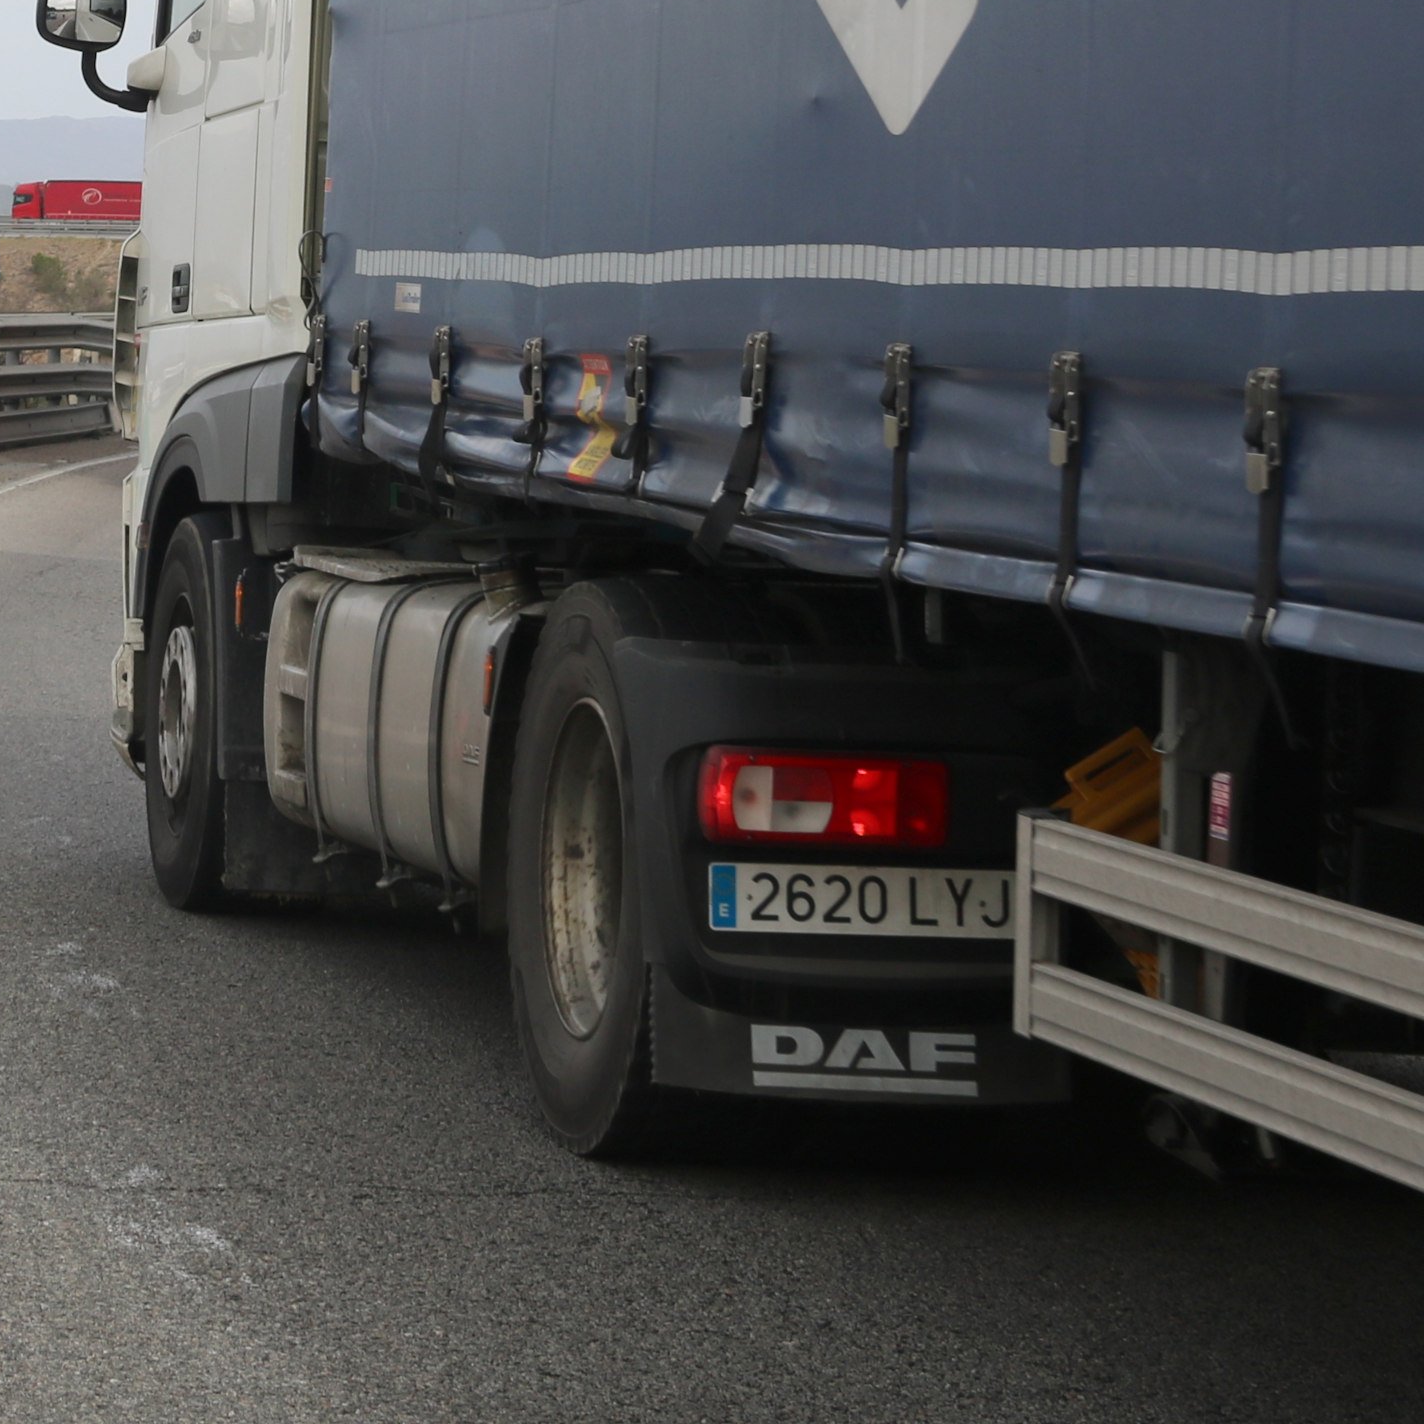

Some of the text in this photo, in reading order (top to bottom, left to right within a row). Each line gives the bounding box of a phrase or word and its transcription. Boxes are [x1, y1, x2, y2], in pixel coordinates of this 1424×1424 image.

[719, 903, 729, 917] E
[751, 872, 1010, 928] 2620 LYJ
[751, 1024, 977, 1072] DAF
